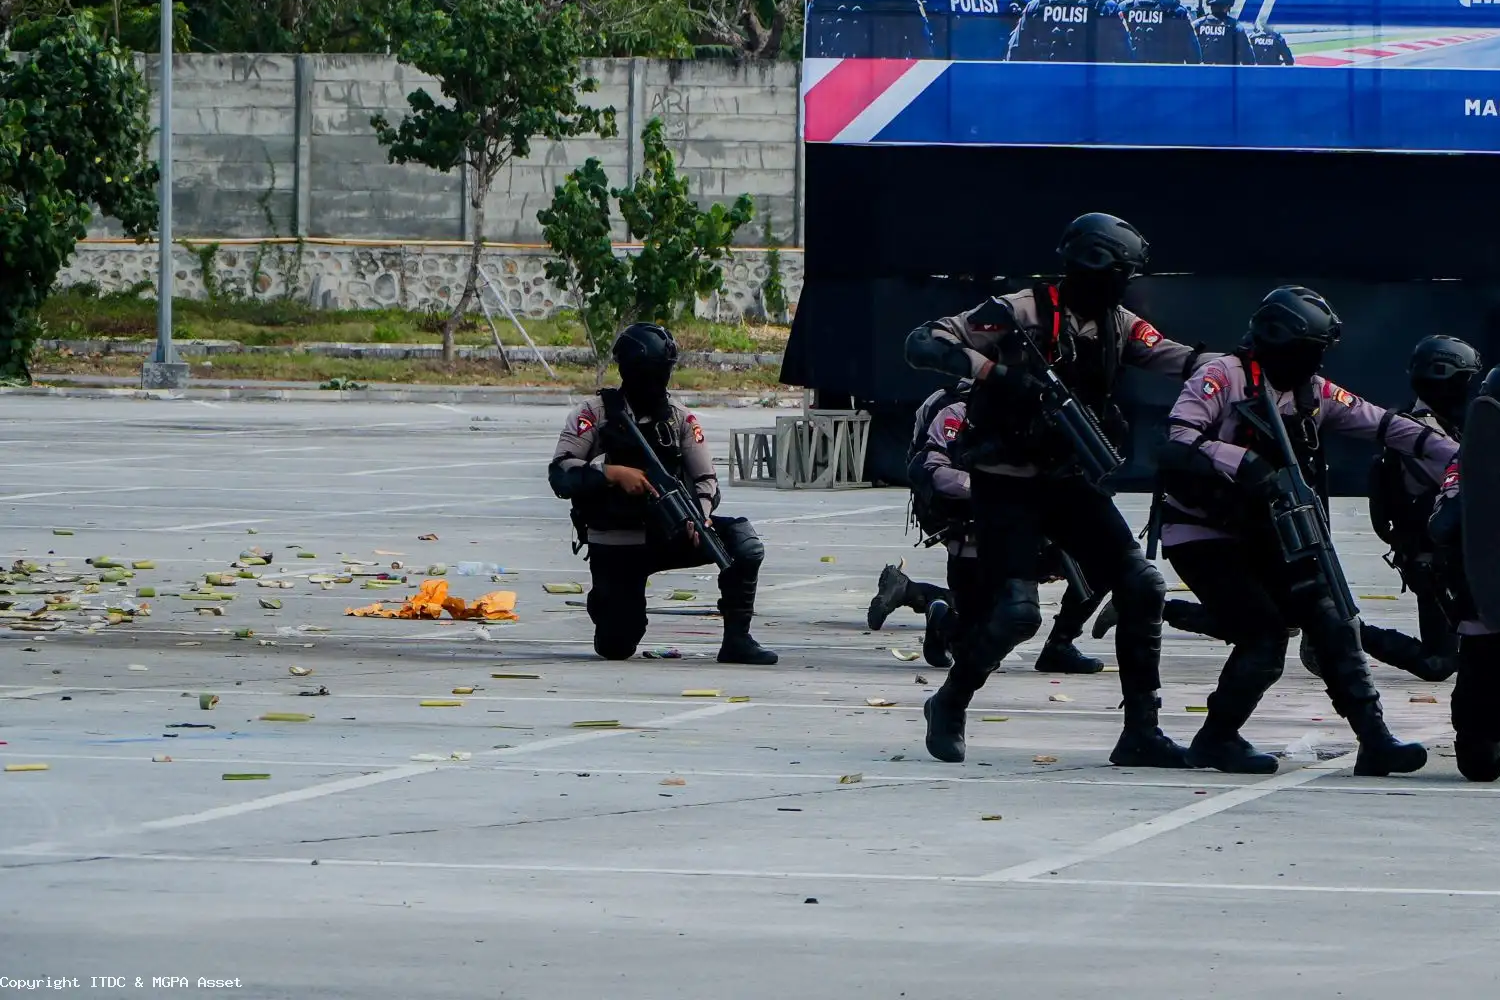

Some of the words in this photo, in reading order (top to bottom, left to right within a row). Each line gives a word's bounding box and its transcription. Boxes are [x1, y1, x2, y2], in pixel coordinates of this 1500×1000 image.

[1043, 6, 1088, 24] POLISI
[1128, 10, 1163, 24] POLISI
[1199, 25, 1226, 37] POLISI
[1254, 37, 1274, 47] POLISI
